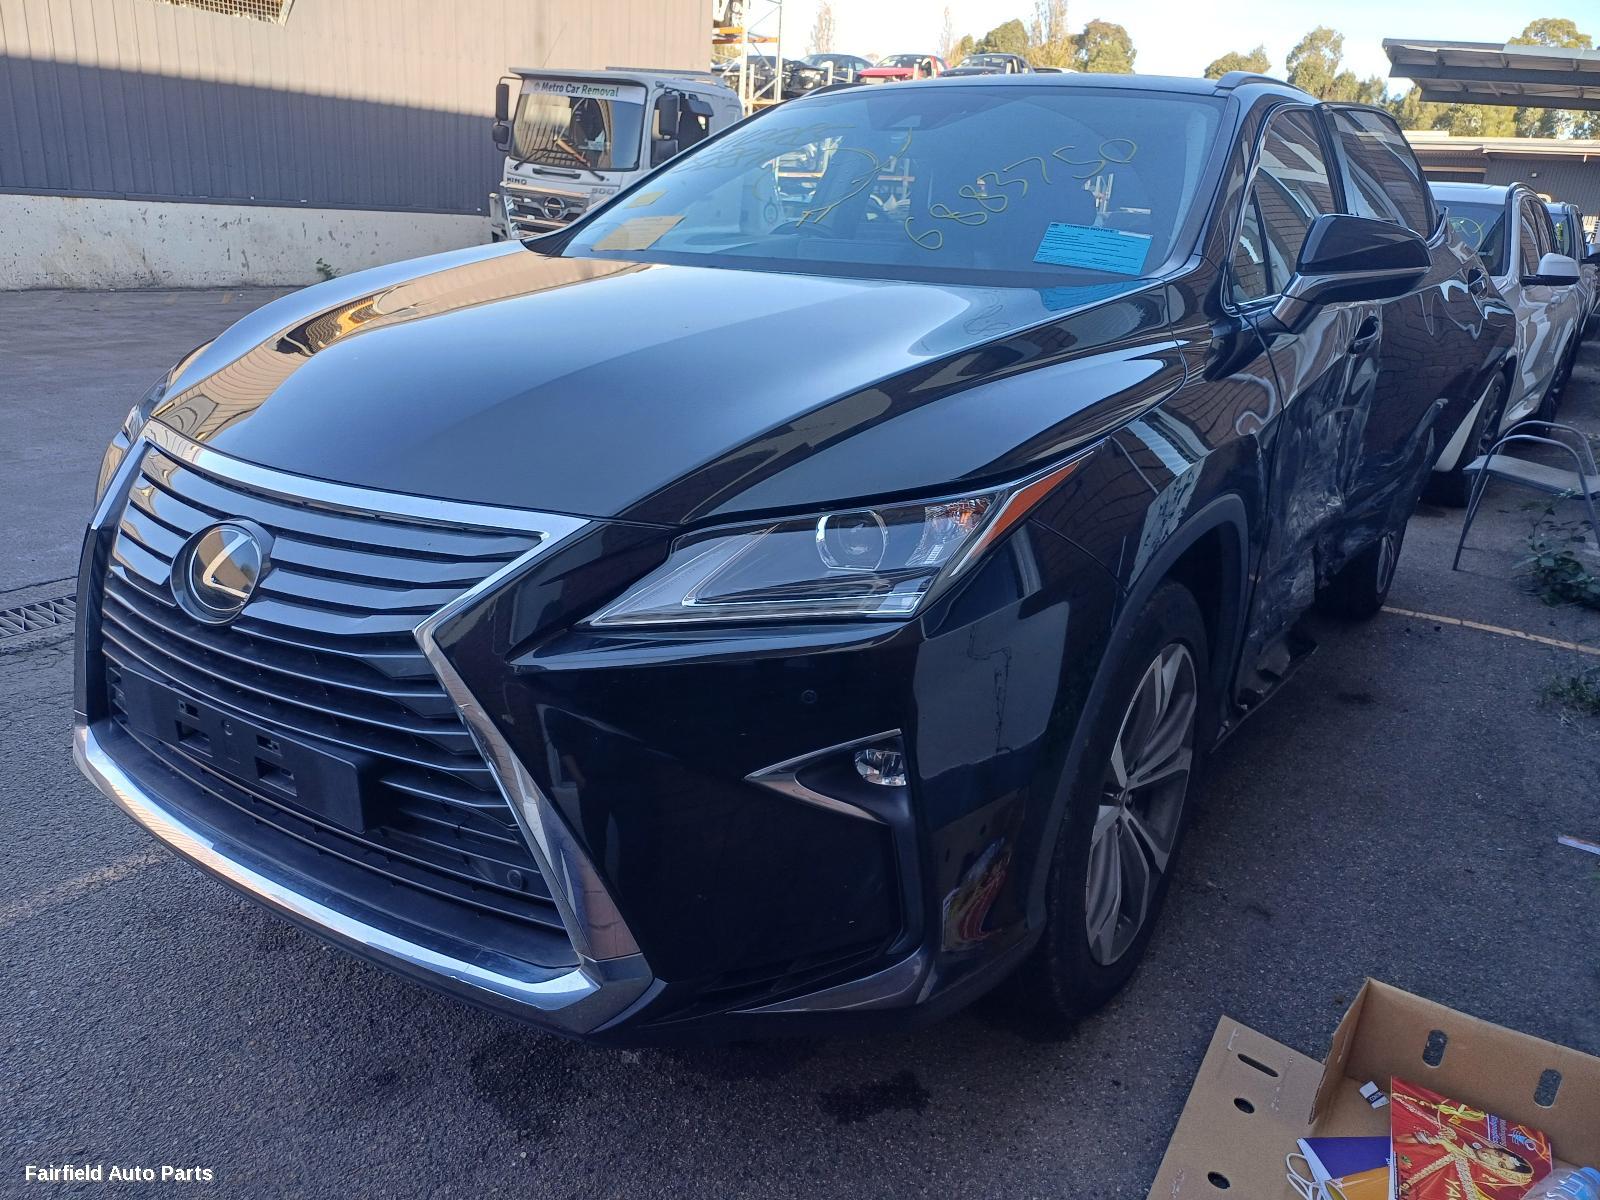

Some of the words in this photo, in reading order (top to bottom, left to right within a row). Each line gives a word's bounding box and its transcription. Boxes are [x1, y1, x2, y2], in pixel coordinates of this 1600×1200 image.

[541, 82, 564, 93] Metro
[565, 83, 580, 94] Car
[581, 84, 619, 97] Removal
[591, 187, 615, 195] 500
